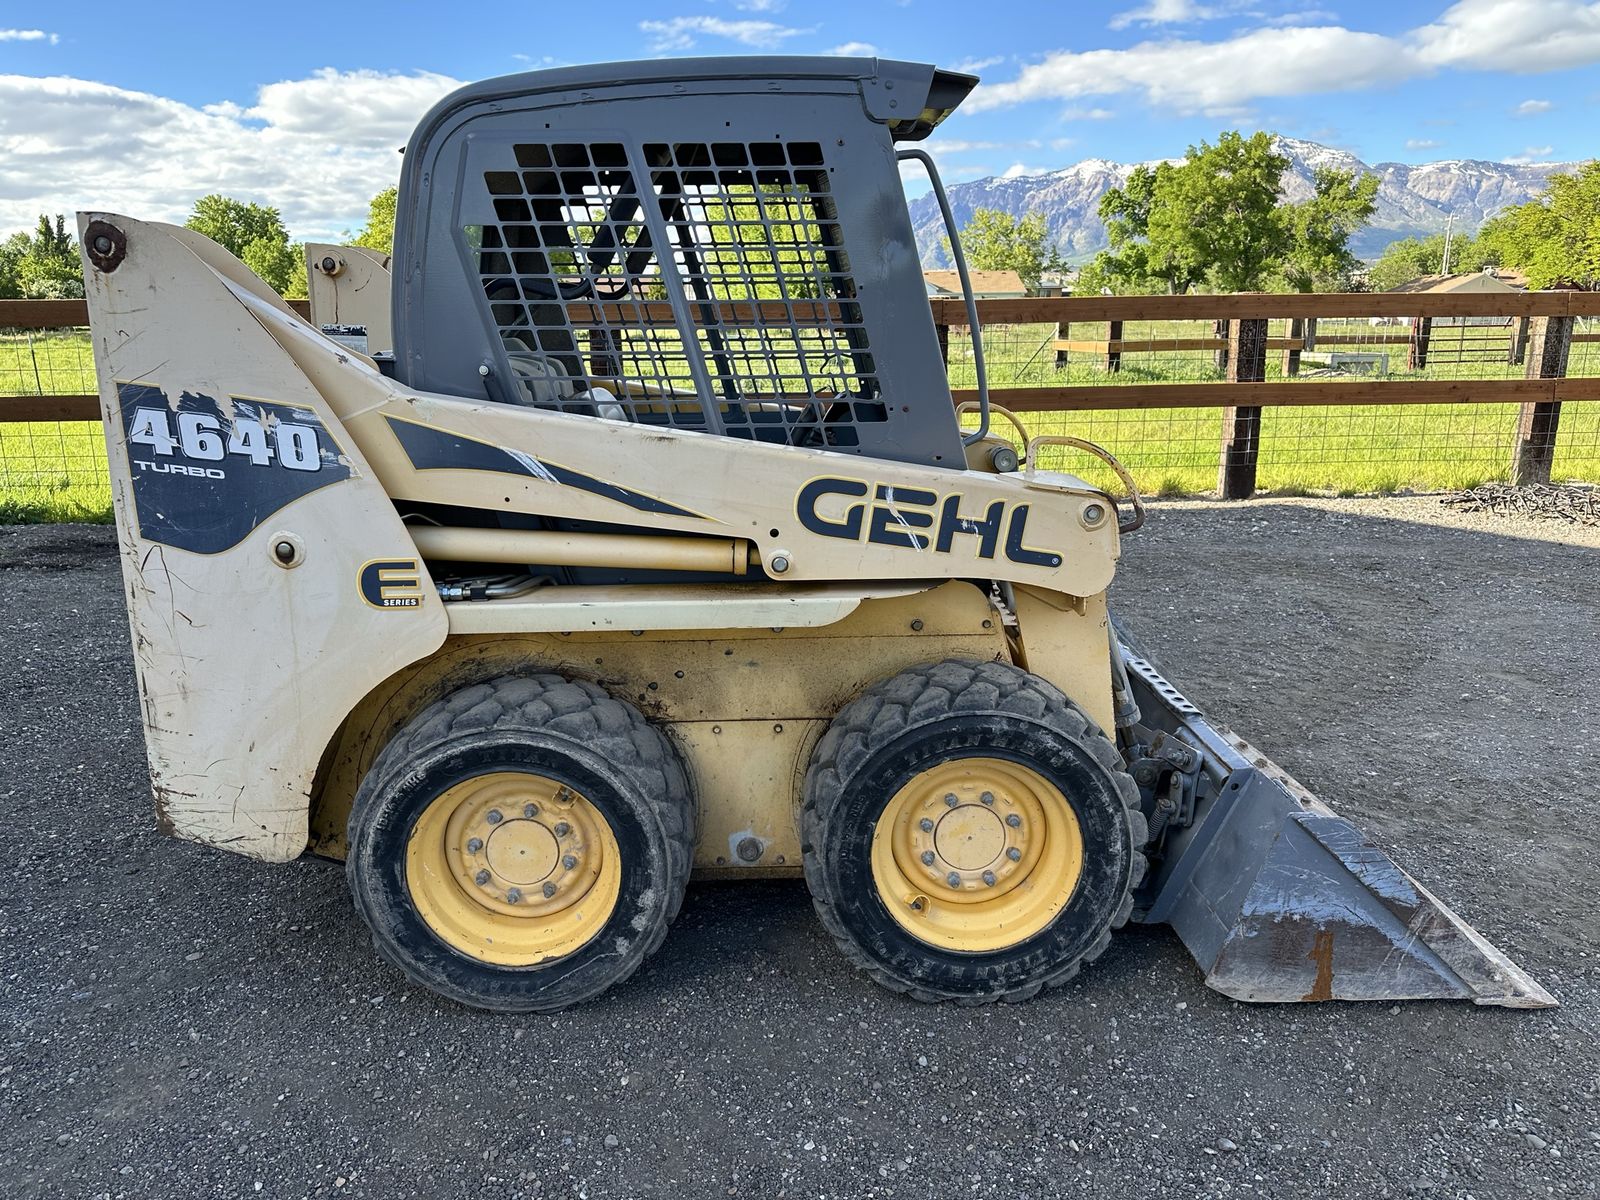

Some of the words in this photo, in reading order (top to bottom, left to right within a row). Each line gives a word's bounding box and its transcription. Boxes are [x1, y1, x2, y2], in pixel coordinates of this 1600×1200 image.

[129, 406, 322, 472] 4640
[133, 460, 225, 480] TURBO
[794, 474, 1064, 568] GEHL
[383, 598, 417, 606] SERIES
